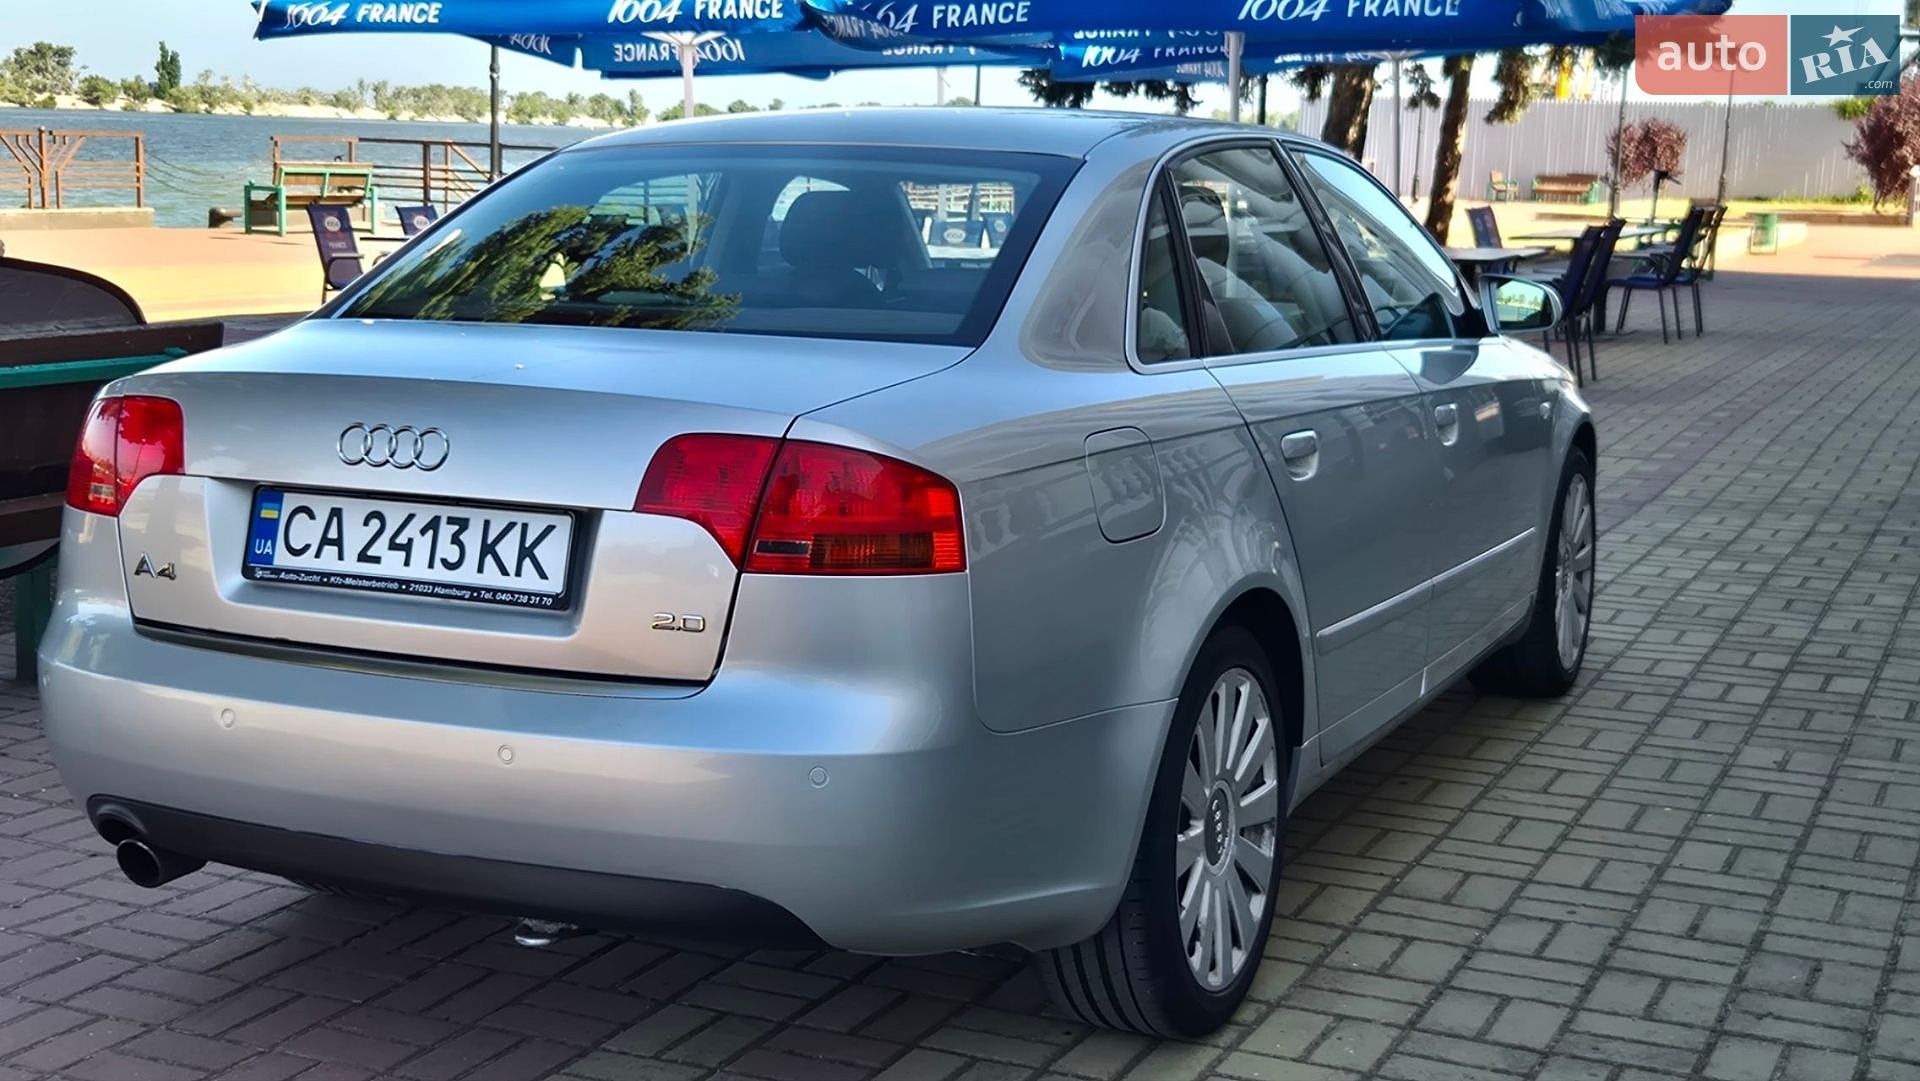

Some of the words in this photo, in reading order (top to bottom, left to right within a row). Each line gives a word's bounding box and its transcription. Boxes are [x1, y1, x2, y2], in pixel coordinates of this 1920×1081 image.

[356, 3, 442, 23] FRANCE
[695, 0, 784, 19] FRANCE
[932, 2, 1031, 29] FRANCE
[1347, 0, 1459, 17] FRANCE
[254, 539, 273, 555] UA
[283, 505, 345, 561] CA
[356, 510, 470, 571] 2413
[476, 519, 557, 580] KK
[134, 552, 176, 581] A4
[278, 571, 321, 583] Auto-Zucht
[329, 576, 400, 590] Kfz-Meisterbetrieb
[408, 583, 433, 593] 21033
[434, 586, 471, 598] Hamburg
[480, 590, 494, 600] Tel.
[496, 592, 528, 604] 040-738
[529, 596, 539, 604] 31
[541, 597, 553, 606] 70
[651, 611, 706, 633] 2.0
